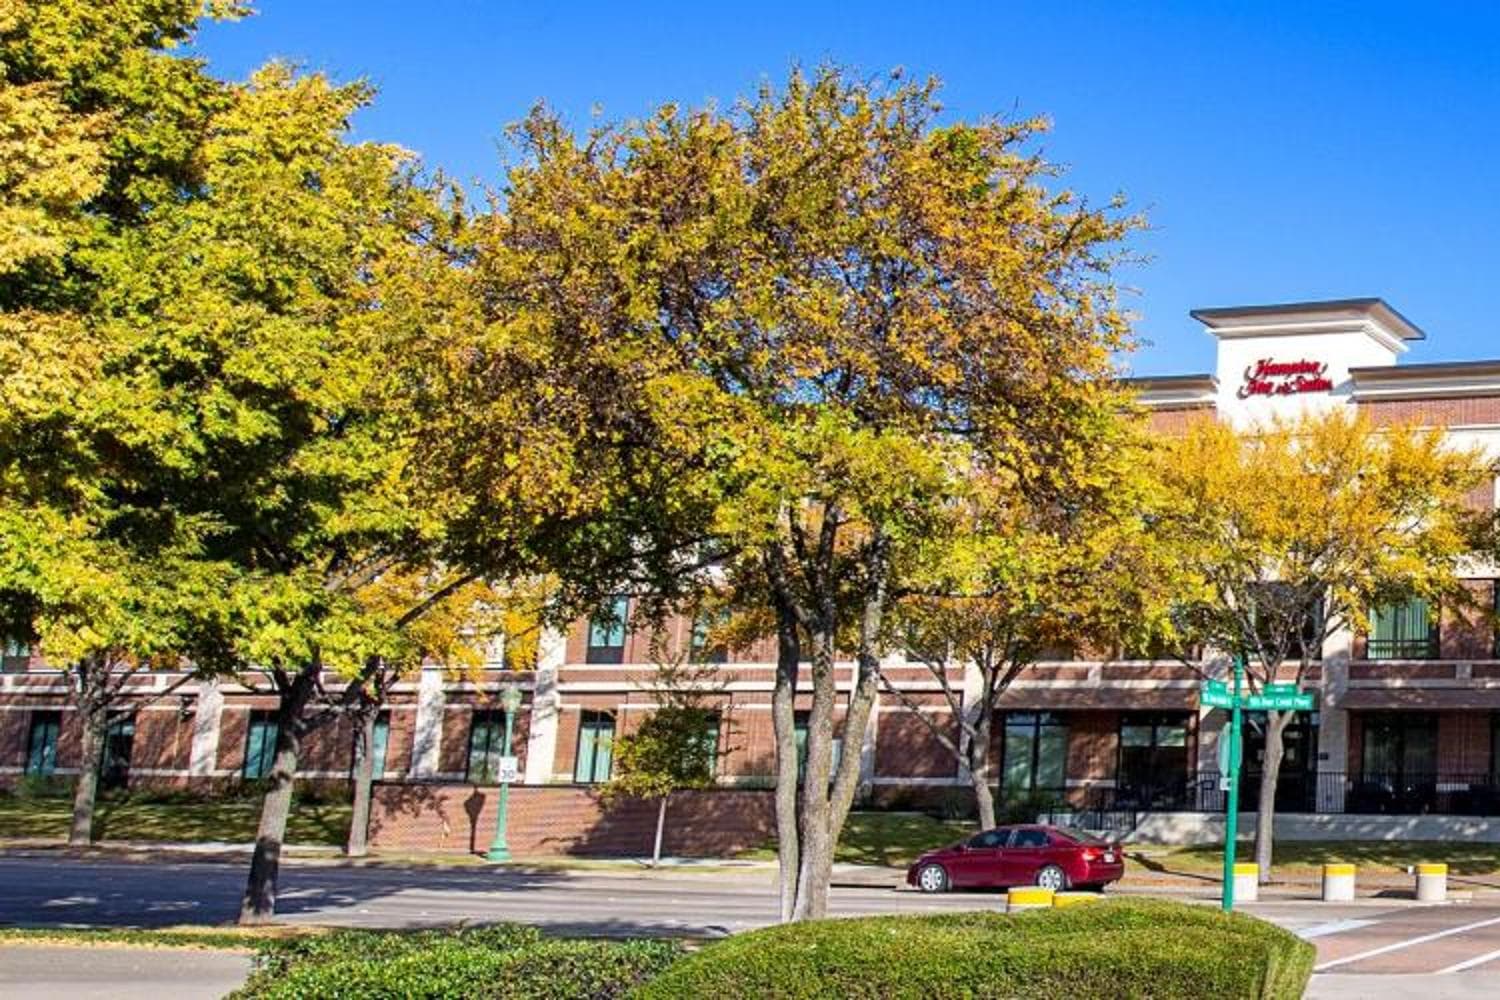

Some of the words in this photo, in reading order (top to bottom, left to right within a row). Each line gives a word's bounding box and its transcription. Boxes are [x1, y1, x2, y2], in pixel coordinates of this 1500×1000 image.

[1244, 358, 1328, 379] Hampton
[1237, 379, 1275, 400] Inn
[1291, 376, 1333, 393] Suites
